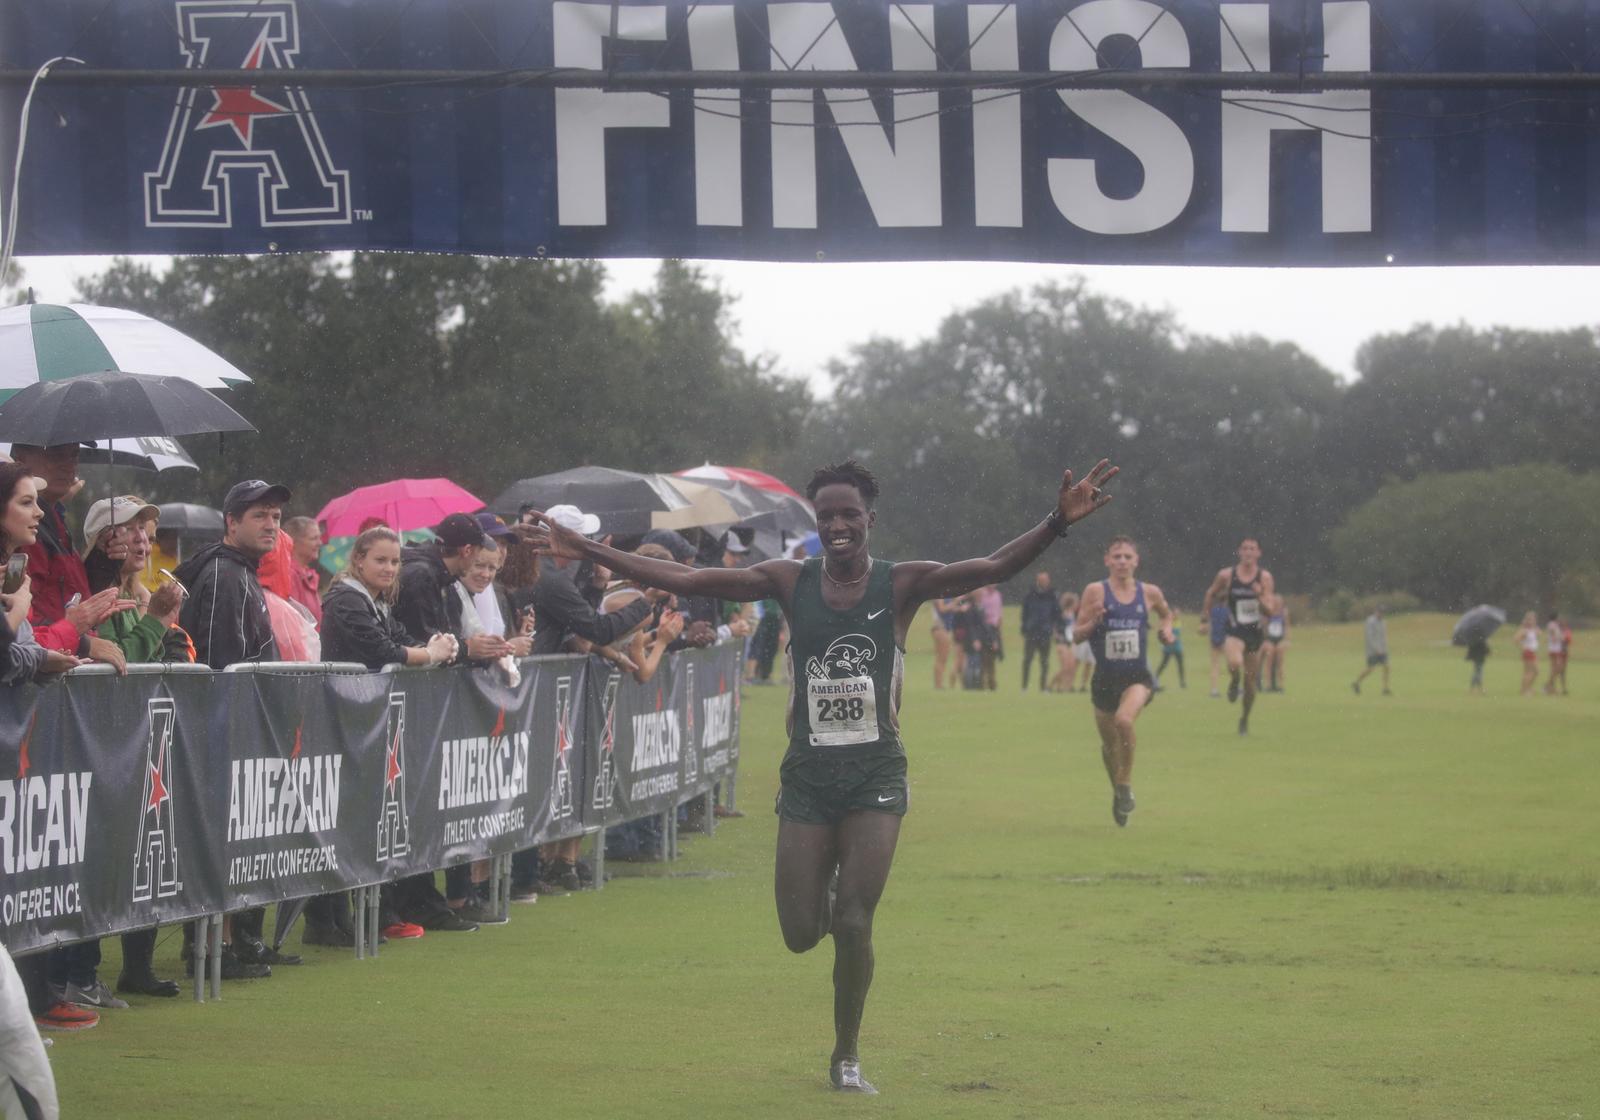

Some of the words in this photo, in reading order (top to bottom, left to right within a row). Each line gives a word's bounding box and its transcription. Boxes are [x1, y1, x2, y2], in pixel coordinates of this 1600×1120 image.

[553, 0, 1373, 235] FINISH
[1112, 640, 1132, 654] 131
[811, 682, 868, 694] AMERICAN
[817, 697, 864, 722] 238
[229, 852, 276, 886] ATHLETIC
[0, 882, 82, 926] ONFERENCE
